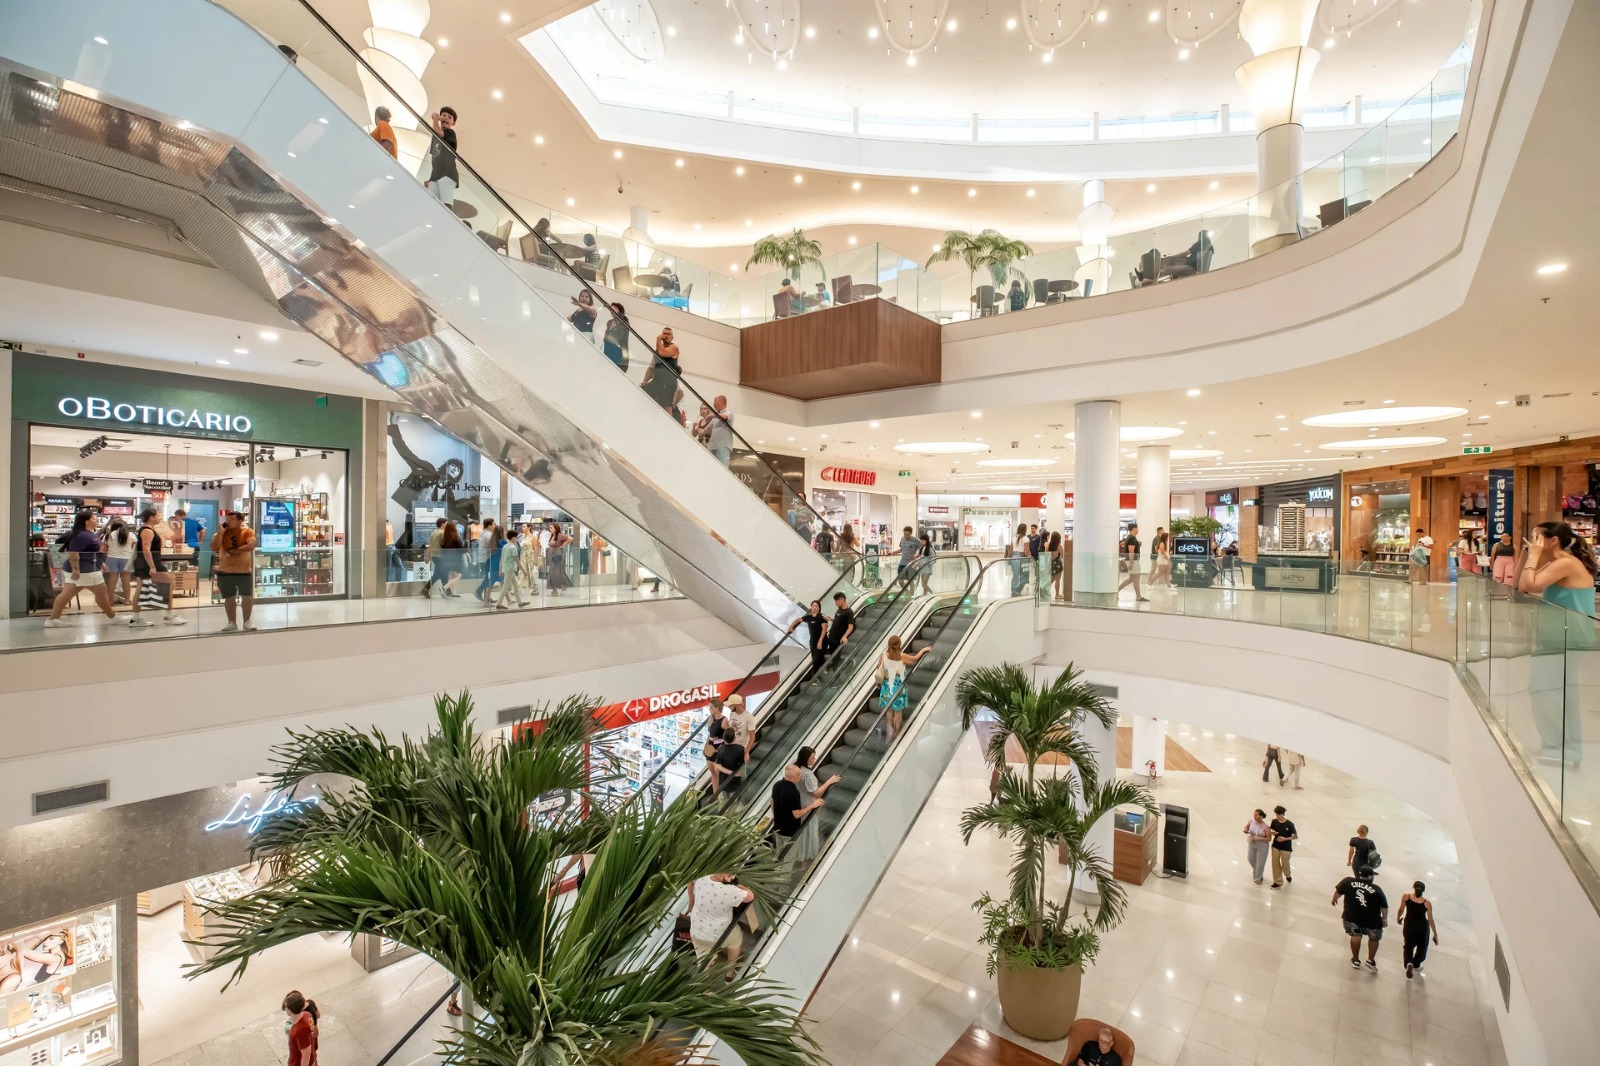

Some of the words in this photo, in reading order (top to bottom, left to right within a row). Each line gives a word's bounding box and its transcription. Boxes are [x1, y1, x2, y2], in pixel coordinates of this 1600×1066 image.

[462, 482, 491, 493] Jeans
[1493, 478, 1506, 539] leitura
[649, 684, 722, 713] DROGASIL
[1350, 881, 1376, 894] CHICAGO
